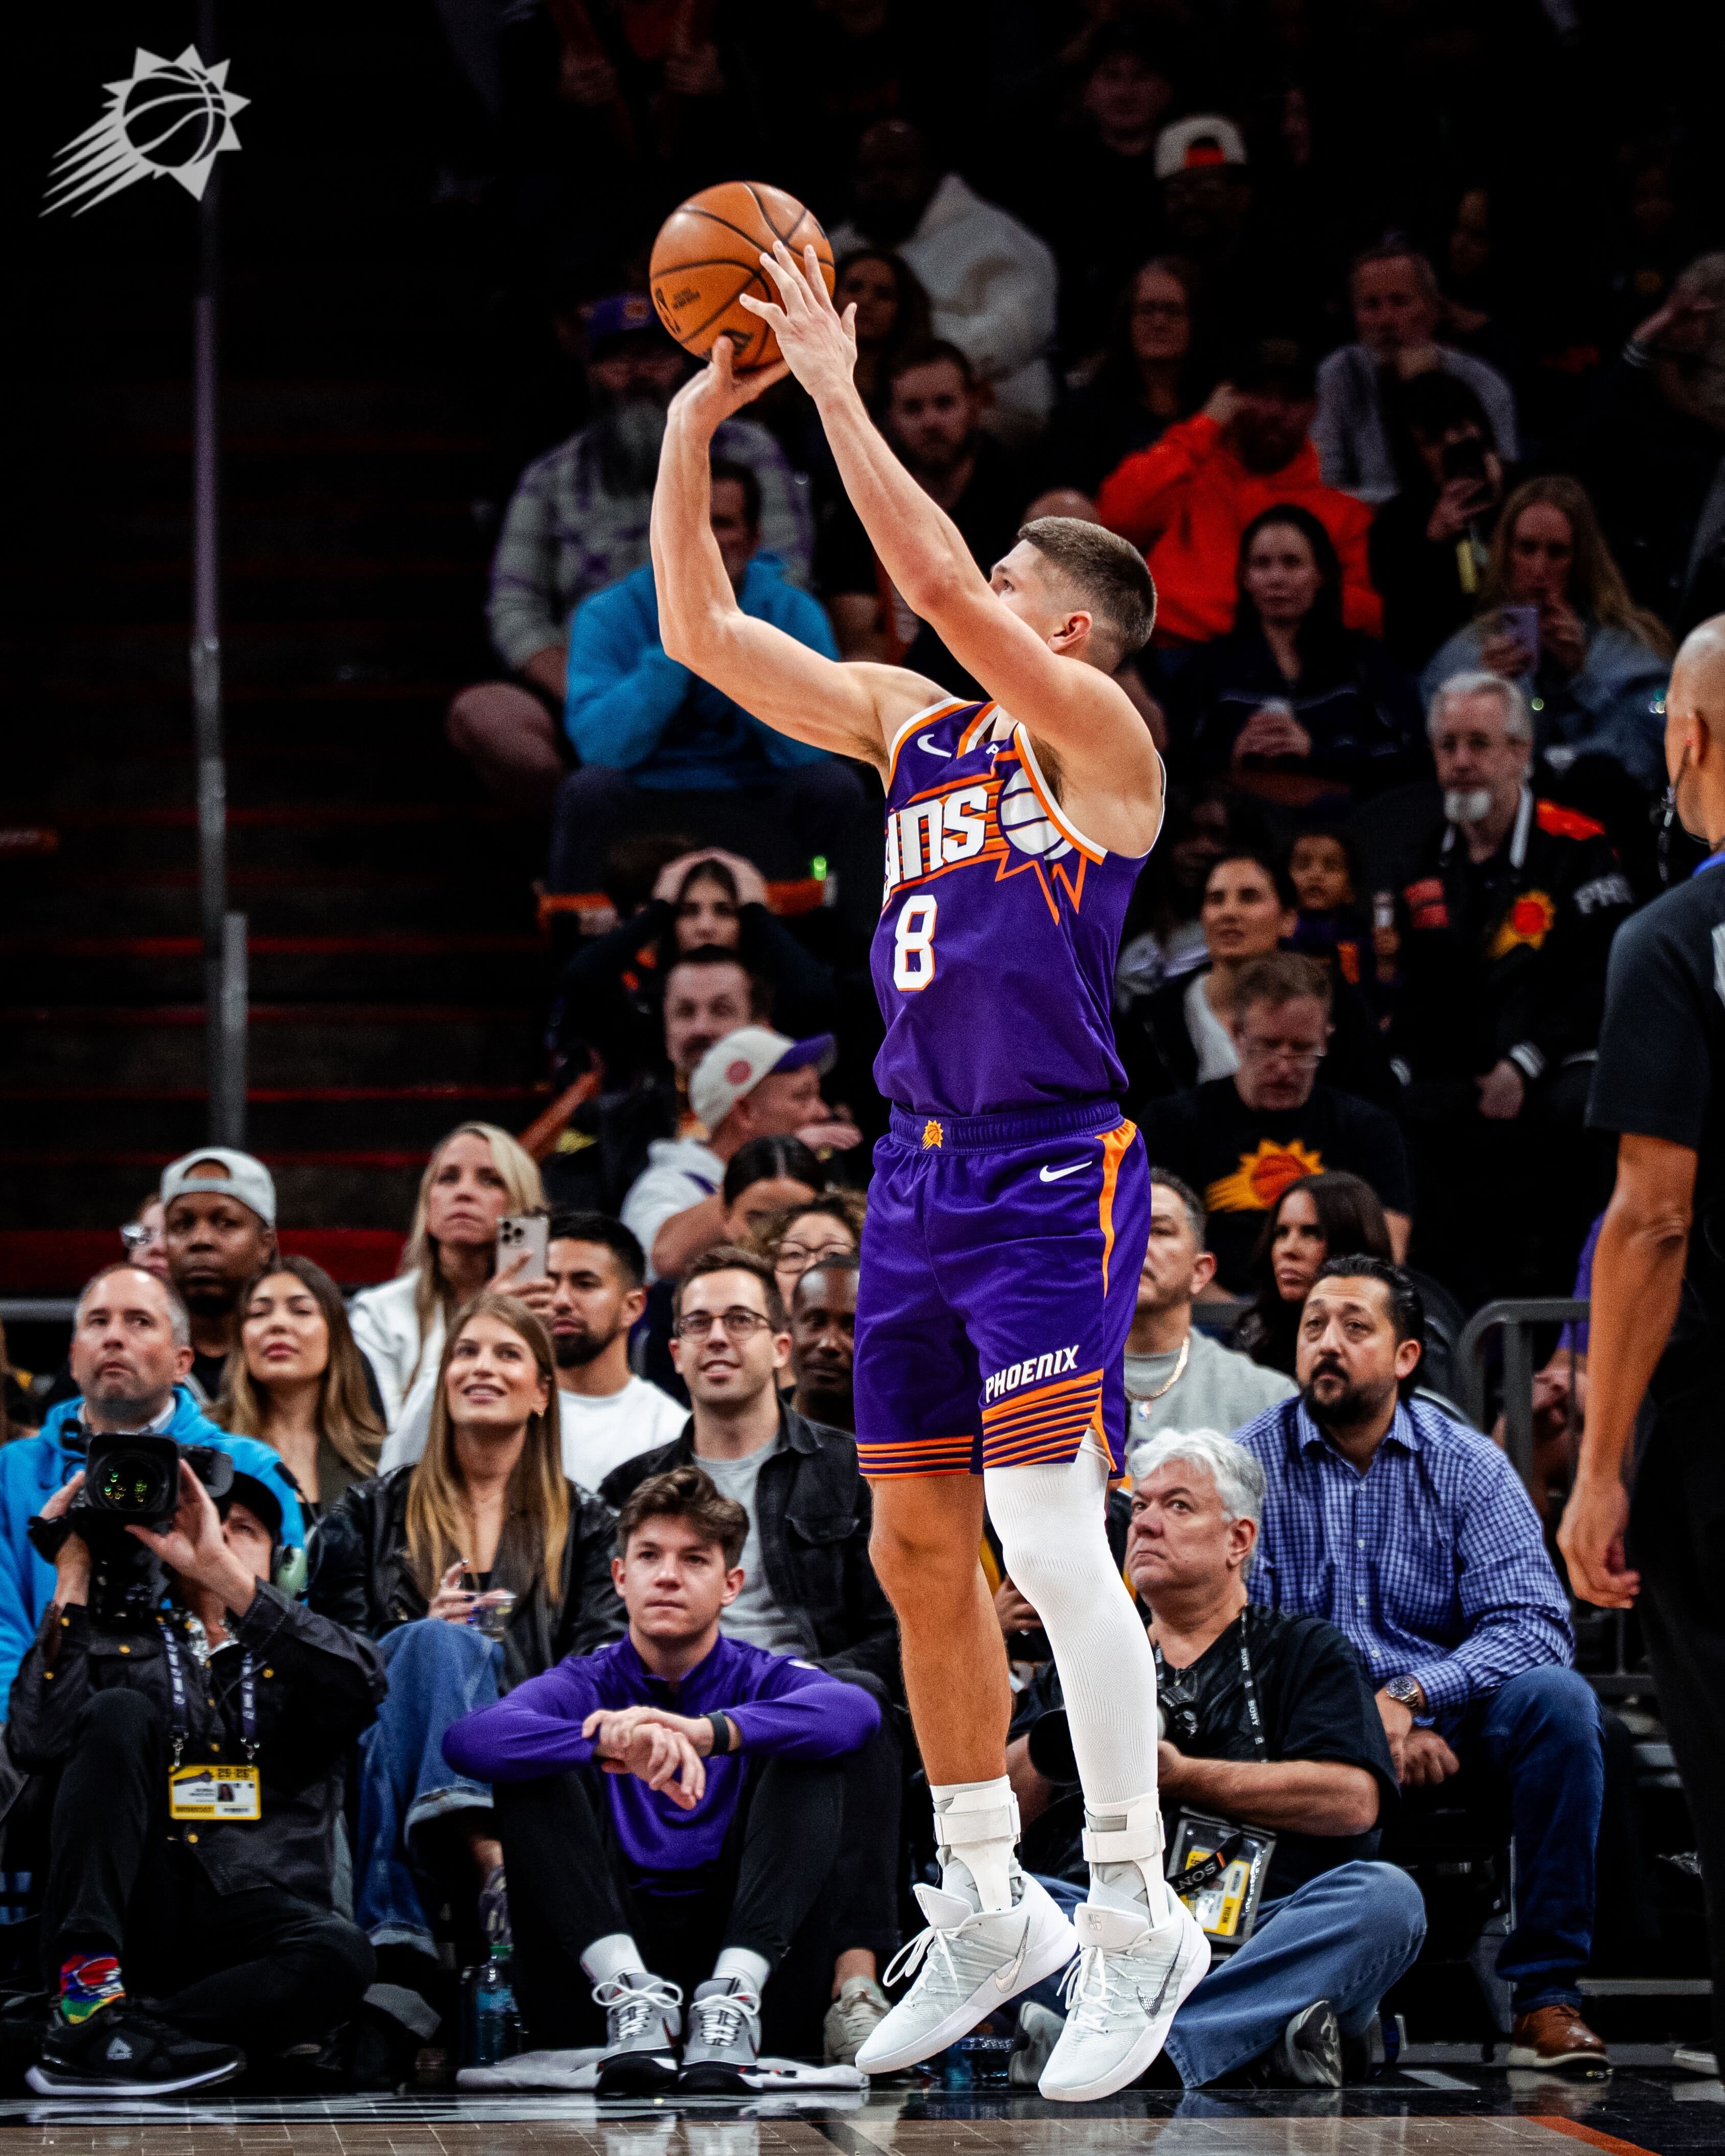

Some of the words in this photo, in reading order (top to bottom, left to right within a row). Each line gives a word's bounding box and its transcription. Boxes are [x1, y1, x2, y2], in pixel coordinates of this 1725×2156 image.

[893, 895, 937, 991] 8
[985, 1345, 1079, 1403] PHOENIX
[1241, 1648, 1250, 1671] SONY
[1248, 1699, 1260, 1726] SONY
[1176, 1862, 1217, 1891] SON
[1221, 1906, 1232, 1924] MEDIA
